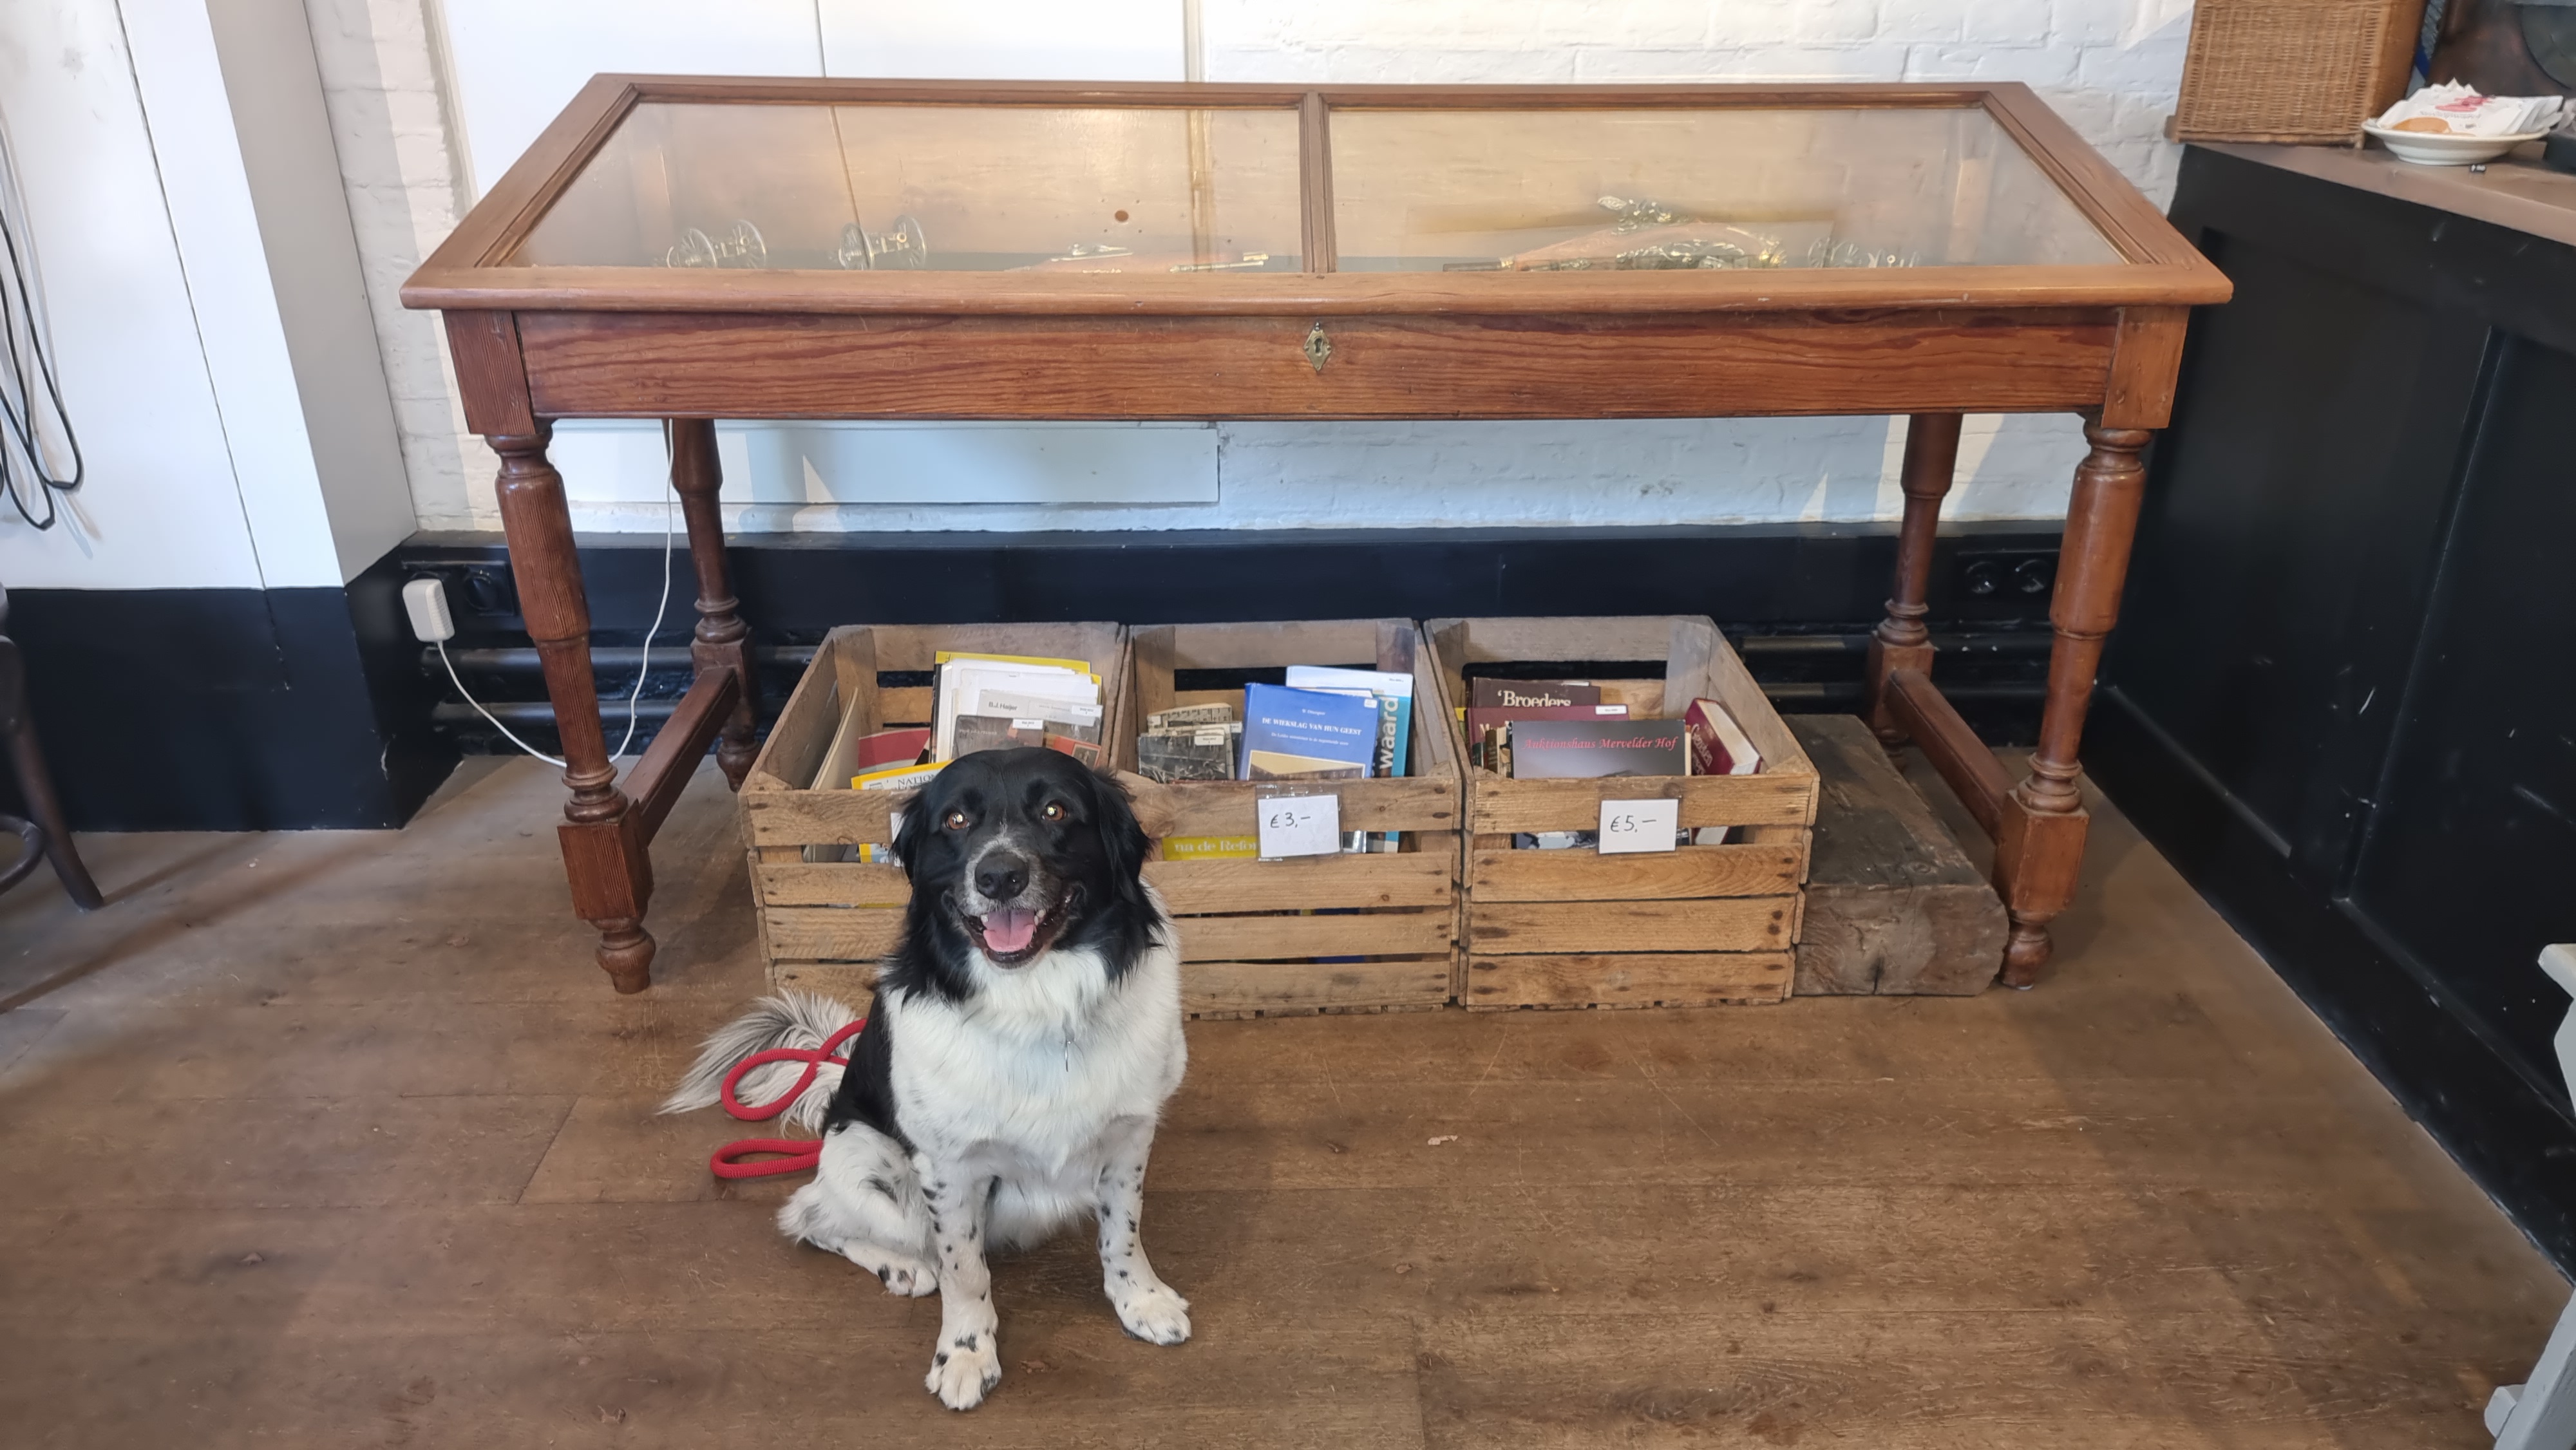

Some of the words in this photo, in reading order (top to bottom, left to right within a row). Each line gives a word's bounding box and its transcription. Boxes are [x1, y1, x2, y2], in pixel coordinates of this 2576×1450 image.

[1273, 719, 1308, 729] WIEKSLAG
[1340, 727, 1362, 735] GEEST
[1379, 696, 1399, 769] waard
[1521, 737, 1595, 750] Auktionshaus
[1599, 737, 1652, 749] Mervelder
[1654, 736, 1679, 751] Hof
[1198, 840, 1216, 851] de
